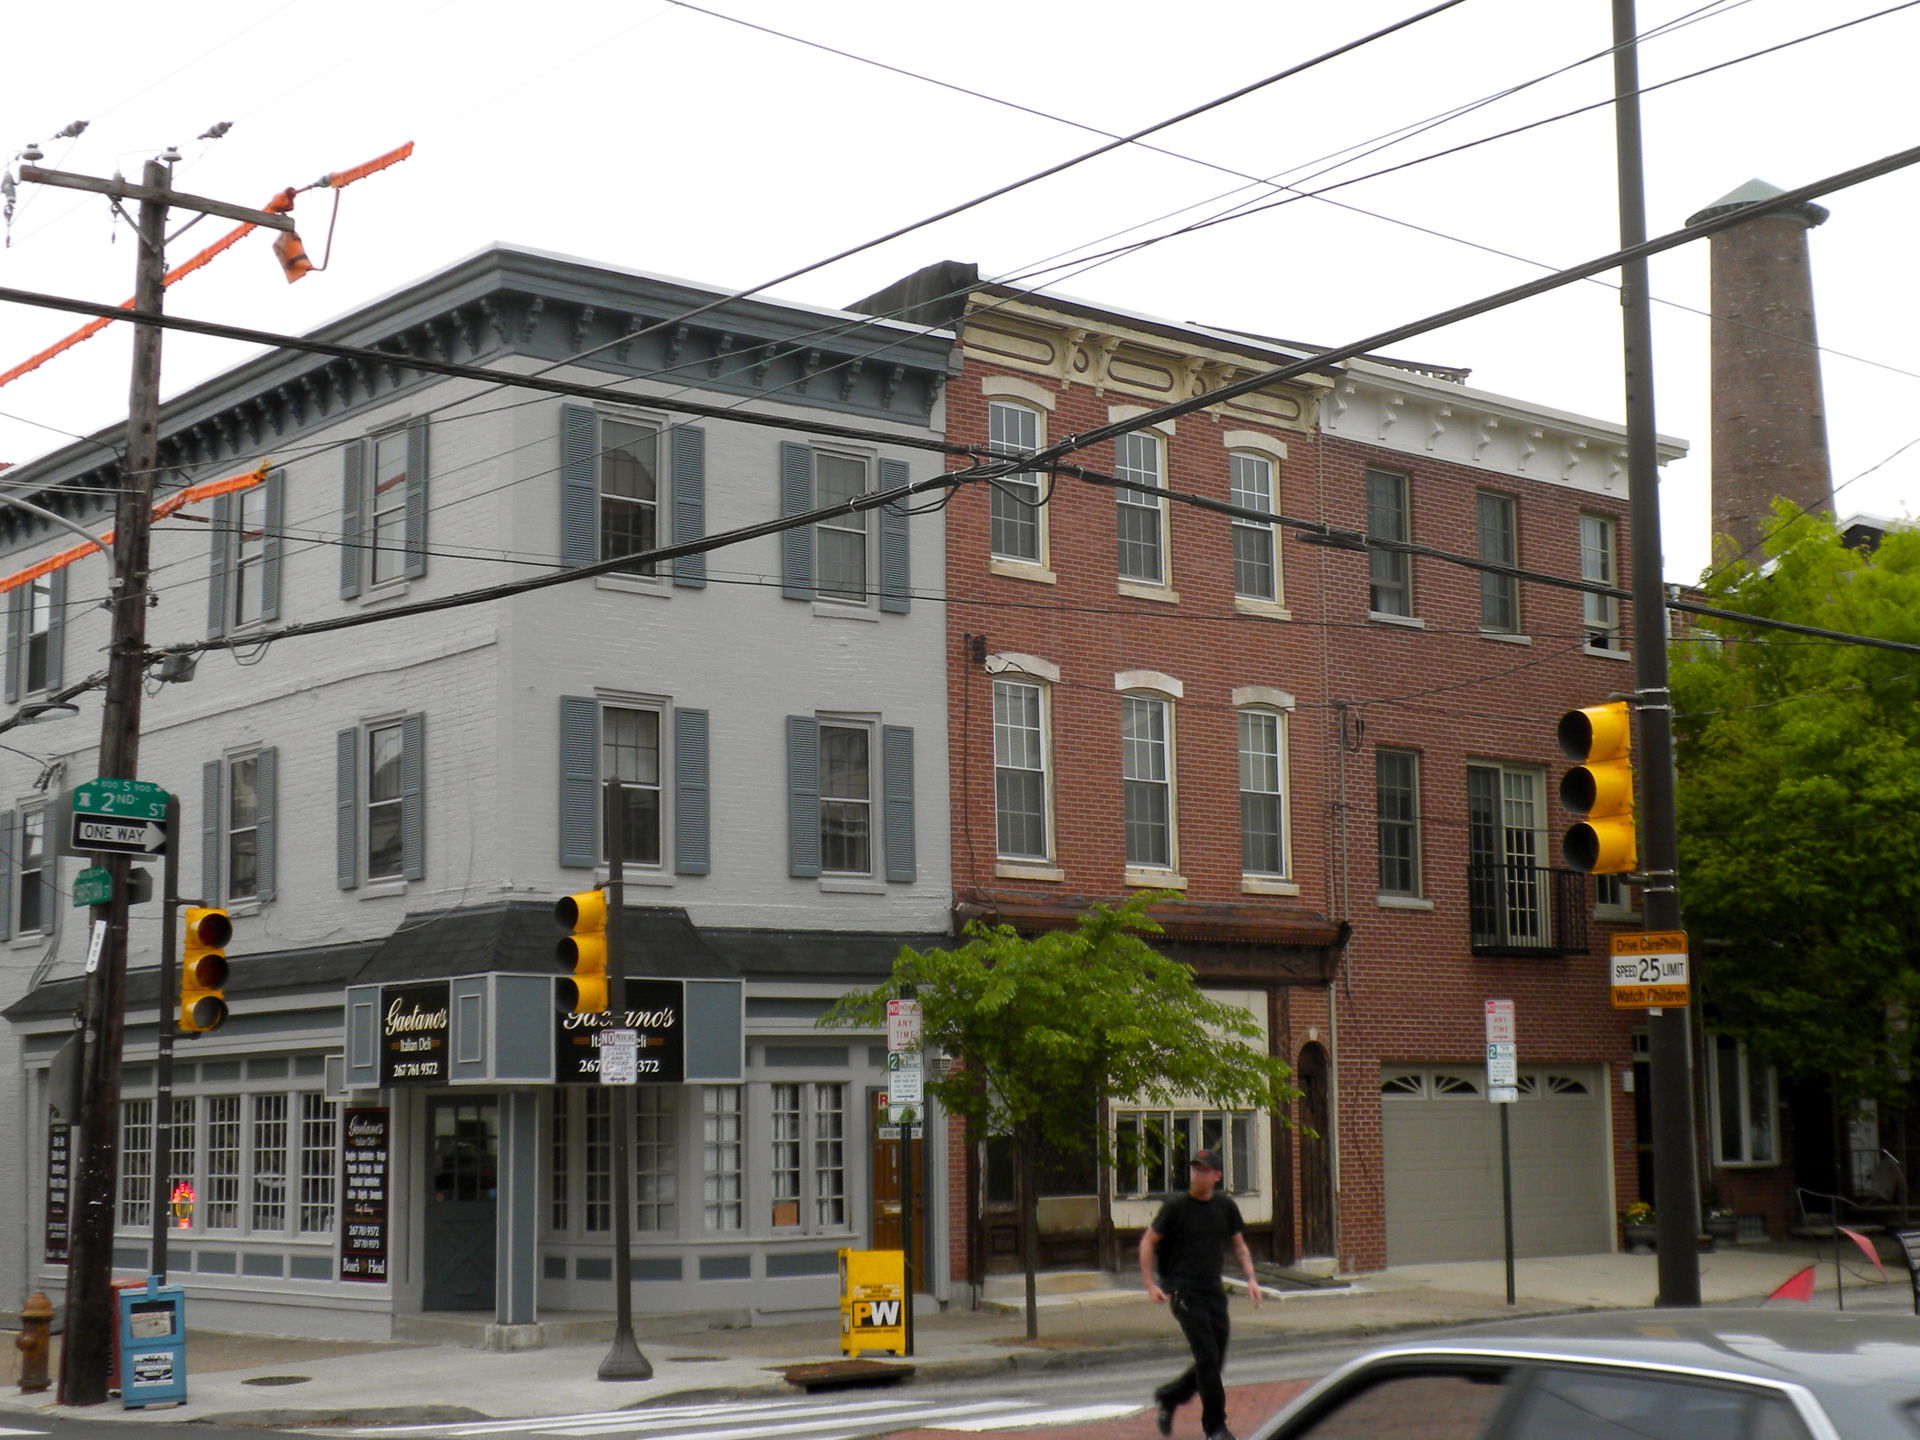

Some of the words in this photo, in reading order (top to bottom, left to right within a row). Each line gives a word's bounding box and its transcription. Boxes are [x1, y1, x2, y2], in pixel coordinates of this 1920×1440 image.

[123, 781, 130, 791] S
[148, 803, 167, 816] ST
[84, 825, 112, 840] ONE
[117, 828, 144, 843] WAY
[1617, 940, 1638, 952] Drive
[1616, 965, 1637, 978] SPEED
[1639, 958, 1660, 982] 25
[1662, 963, 1684, 976] LIMIT
[1616, 990, 1645, 1002] Watch
[1648, 988, 1687, 1002] Children
[385, 997, 448, 1036] Gaetano's
[400, 1038, 418, 1052] Italian
[418, 1037, 432, 1050] Deli
[601, 1032, 614, 1045] NO
[635, 1034, 647, 1048] eli
[1489, 1046, 1496, 1057] 2
[579, 1060, 600, 1072] 267
[636, 1060, 659, 1072] 372
[890, 1055, 898, 1069] 2
[393, 1065, 406, 1077] 267
[407, 1063, 419, 1076] 761
[420, 1062, 438, 1075] 9372
[368, 1260, 385, 1274] Head
[854, 1302, 899, 1326] PW
